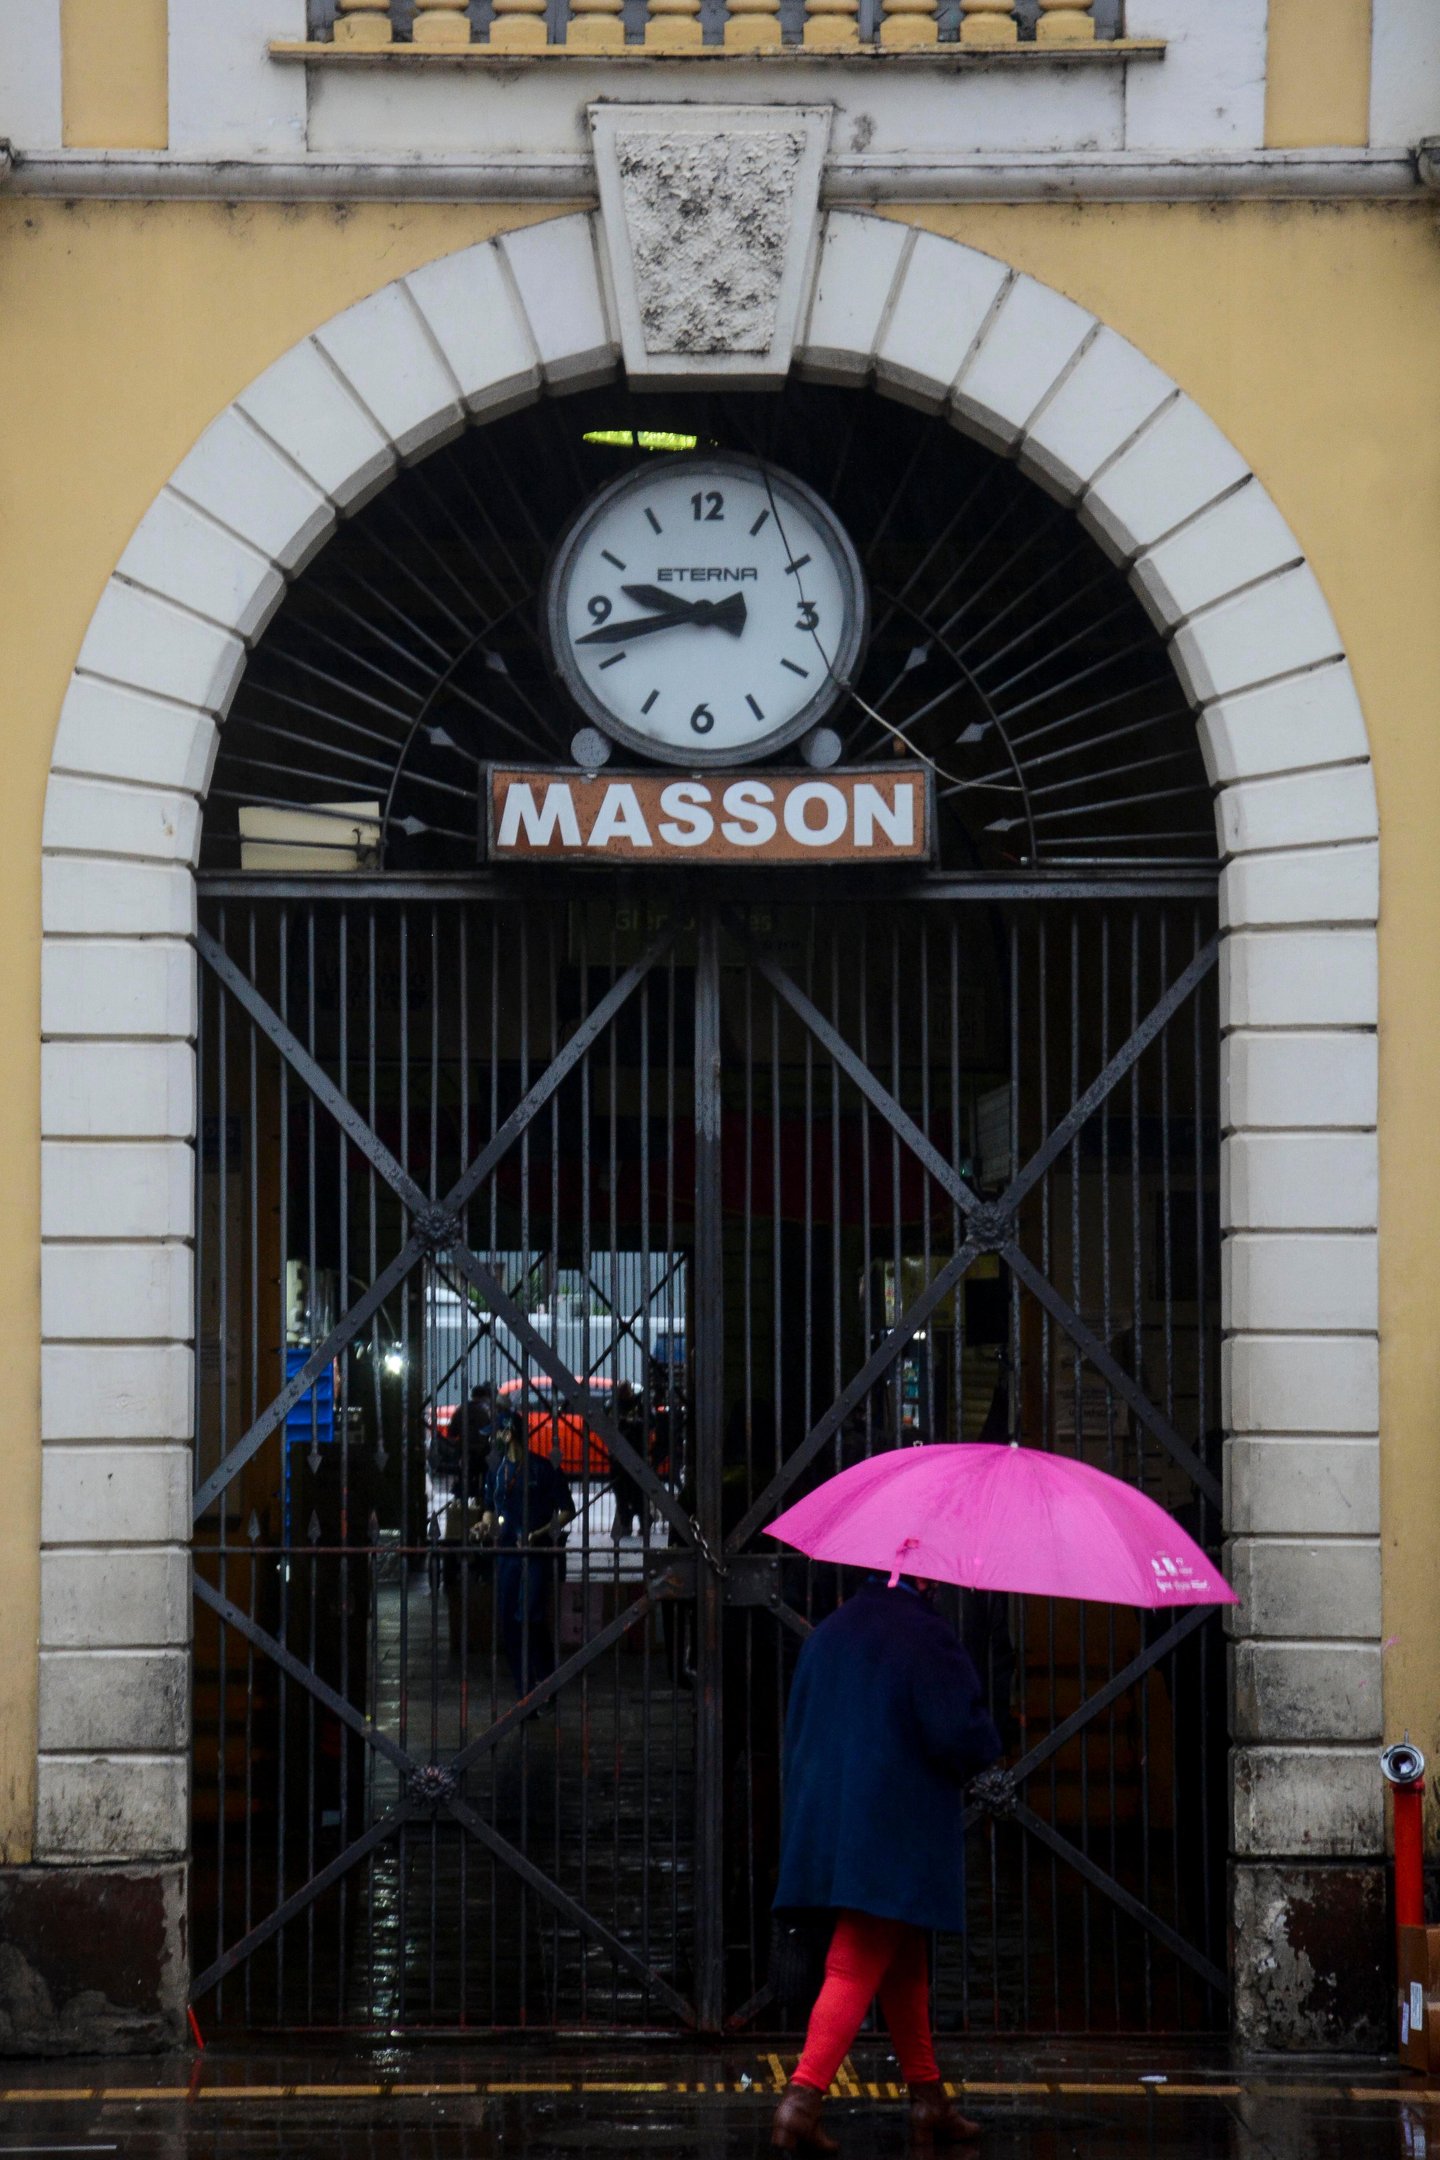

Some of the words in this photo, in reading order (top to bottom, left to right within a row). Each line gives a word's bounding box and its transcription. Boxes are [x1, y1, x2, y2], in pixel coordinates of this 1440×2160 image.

[690, 491, 725, 521] 12
[656, 567, 758, 582] ETERNA
[587, 595, 613, 626] 9
[795, 601, 819, 632] 3
[690, 703, 715, 734] 6
[497, 780, 914, 847] MASSON
